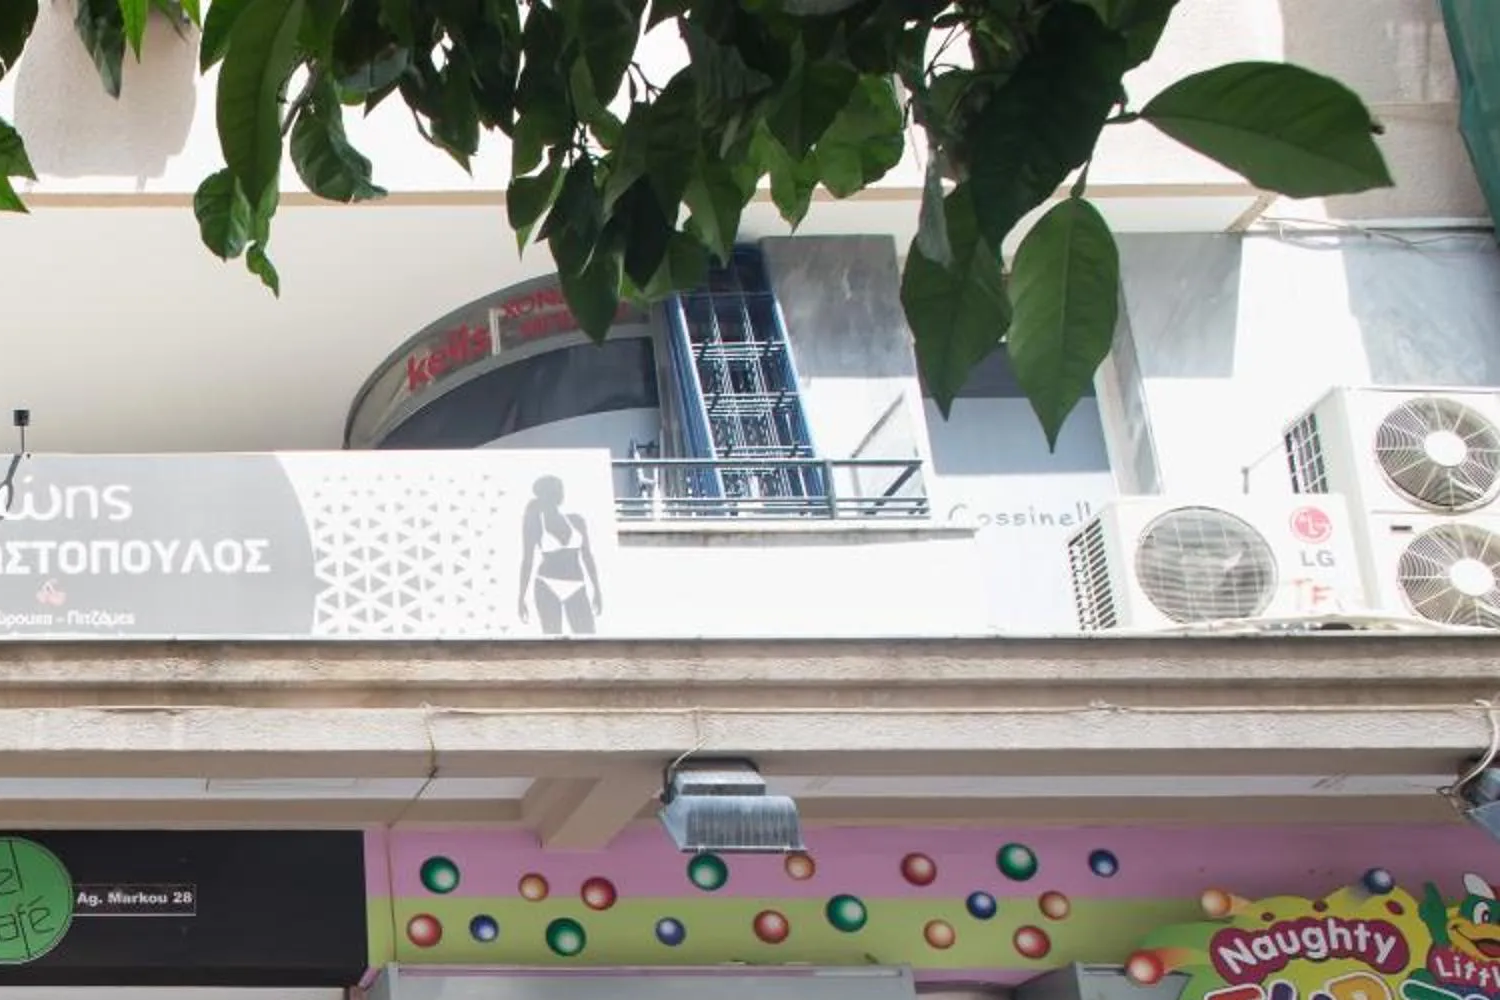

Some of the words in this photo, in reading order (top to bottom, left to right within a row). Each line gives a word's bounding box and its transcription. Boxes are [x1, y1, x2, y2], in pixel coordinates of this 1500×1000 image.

[949, 501, 1091, 527] Cossinell
[1300, 549, 1335, 568] LG
[107, 891, 168, 905] Markou
[173, 891, 193, 904] 28
[1217, 918, 1397, 975] Naughty
[1436, 956, 1500, 988] Littl
